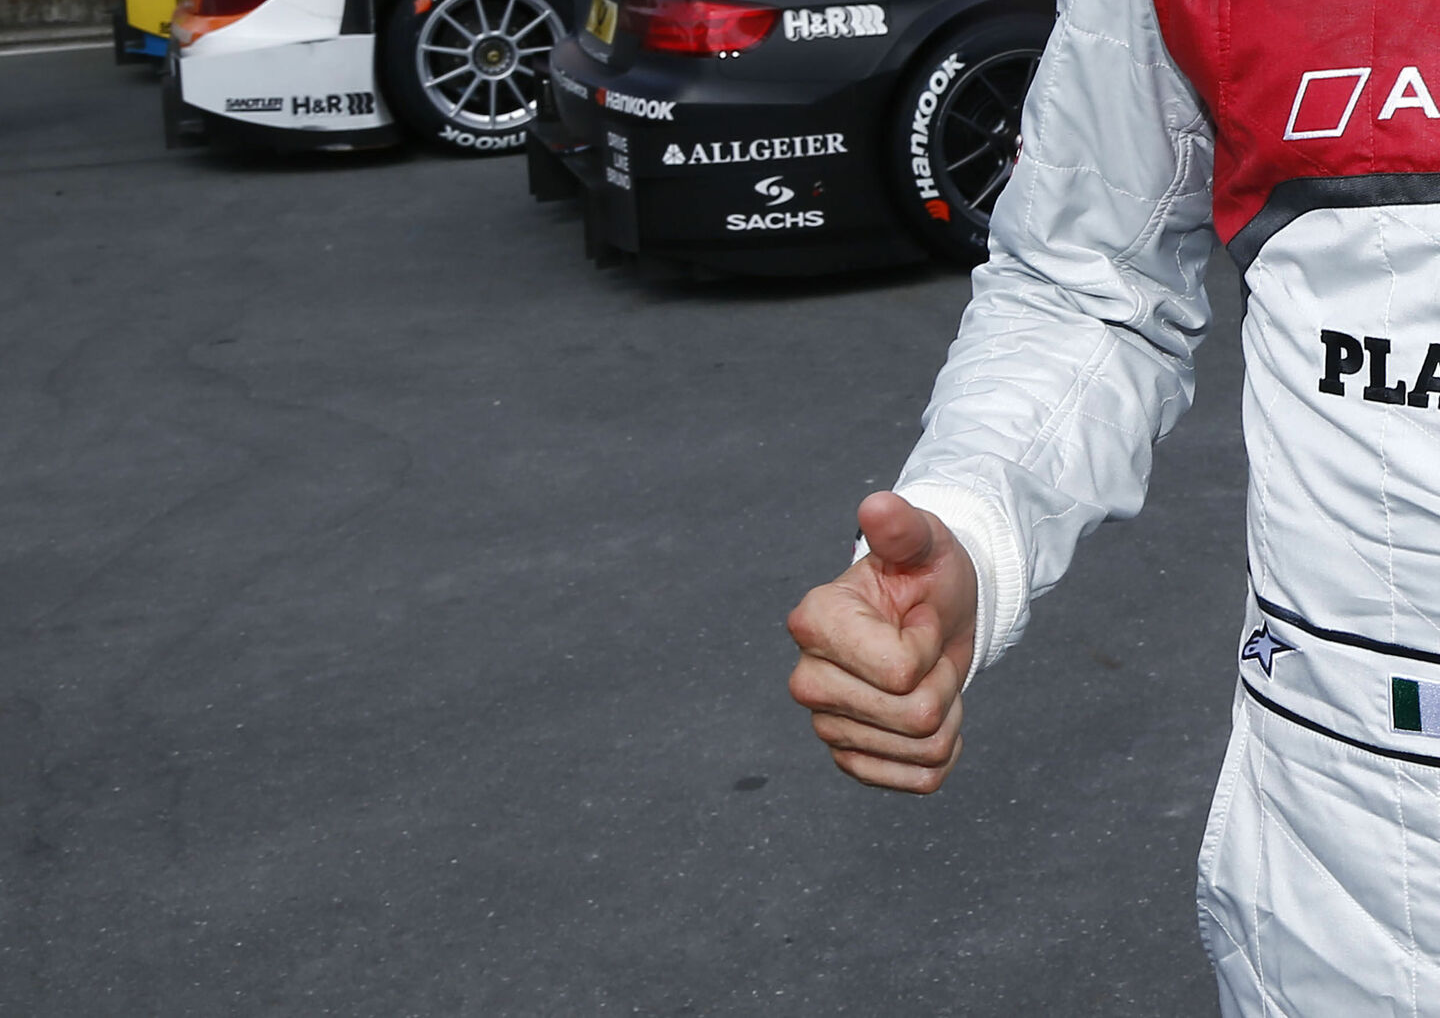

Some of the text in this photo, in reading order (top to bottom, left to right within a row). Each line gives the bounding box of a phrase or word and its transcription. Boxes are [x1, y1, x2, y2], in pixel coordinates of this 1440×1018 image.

[783, 6, 849, 41] H&R
[292, 95, 342, 115] H&R
[687, 133, 848, 165] ALLGEIER
[726, 210, 824, 231] SACHS
